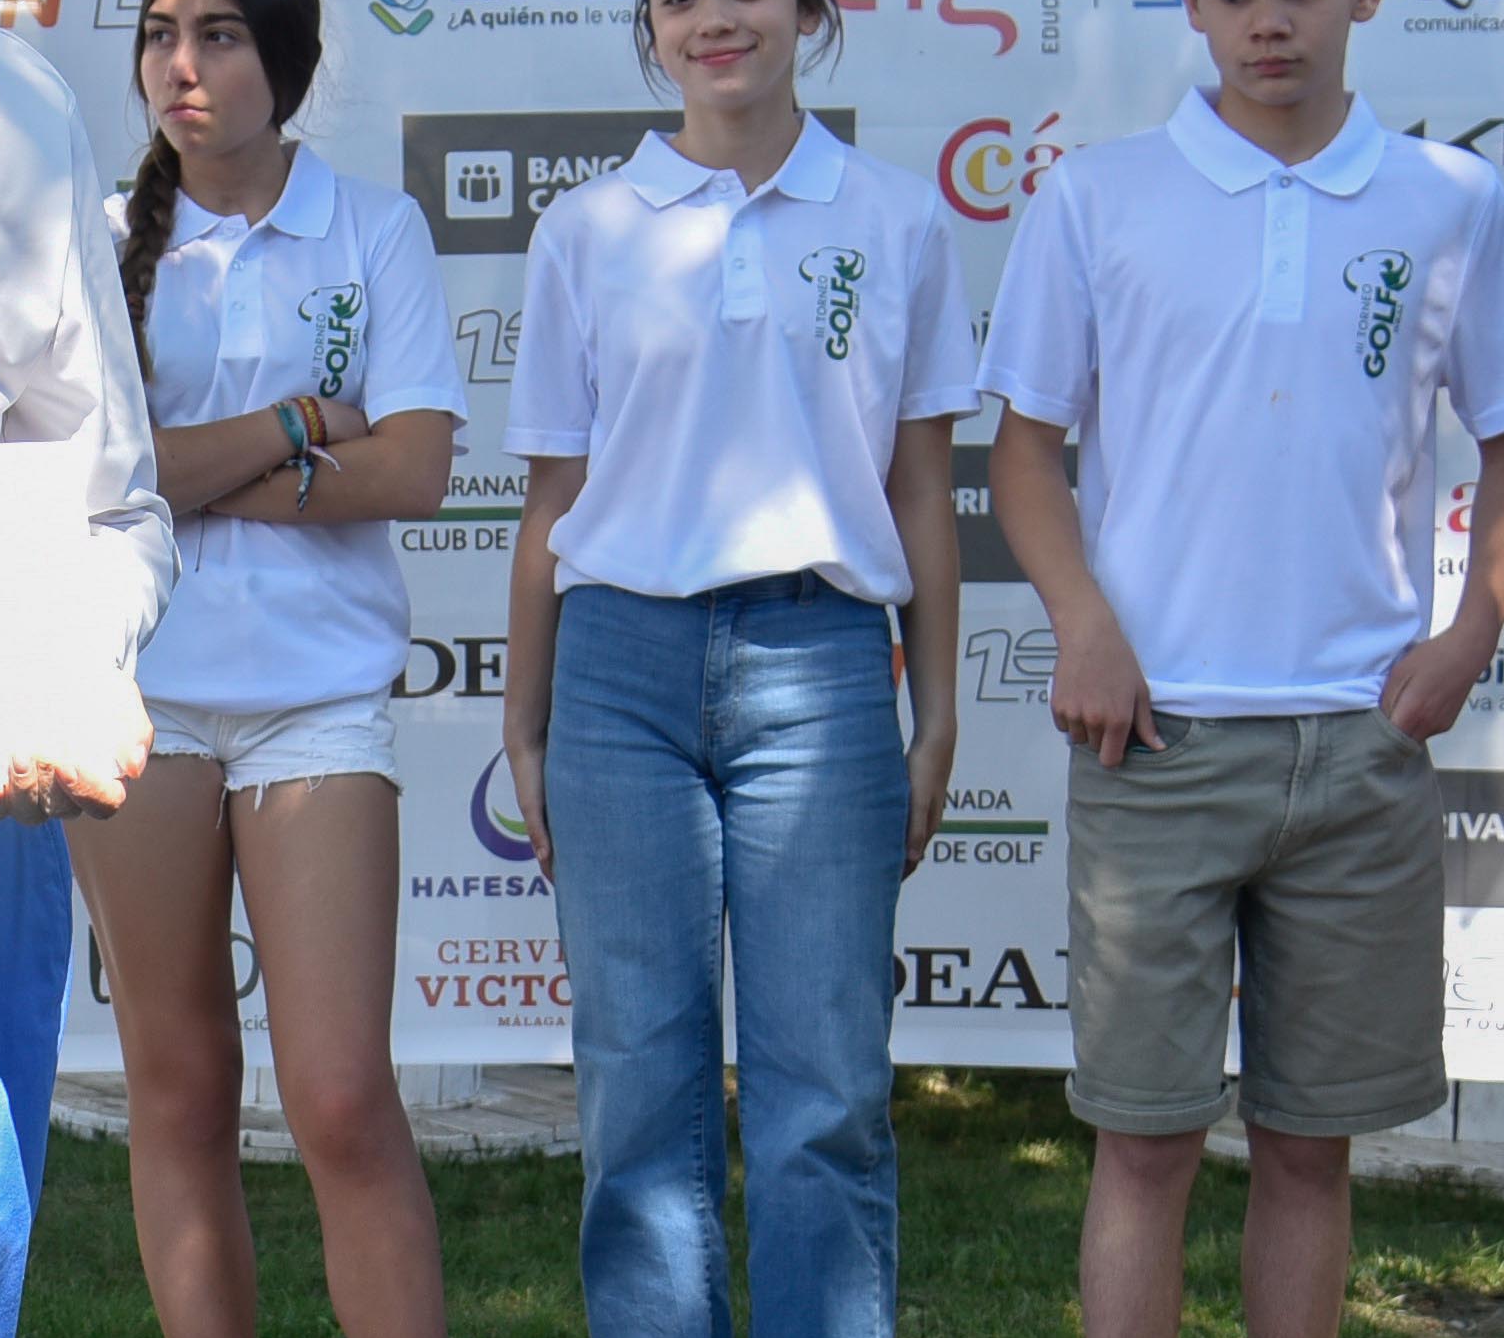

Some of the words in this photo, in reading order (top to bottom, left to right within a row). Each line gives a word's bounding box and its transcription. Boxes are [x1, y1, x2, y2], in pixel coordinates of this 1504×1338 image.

[447, 7, 483, 31] ¿A
[488, 3, 547, 30] quién
[550, 8, 579, 26] no
[583, 4, 605, 26] le
[526, 156, 624, 186] BANC
[815, 274, 828, 322] TORNEO
[1356, 283, 1373, 337] TORNEO
[825, 275, 854, 361] GOLF
[1362, 285, 1397, 379] GOLF
[313, 312, 327, 365] TORNEO
[319, 316, 352, 399] GOLF
[400, 527, 468, 552] CLUB
[473, 526, 509, 551] DE
[1468, 695, 1494, 713] va
[941, 788, 1012, 811] NADA
[933, 840, 968, 864] DE
[973, 839, 1044, 866] GOLF
[411, 875, 550, 899] HAFESA
[415, 974, 573, 1008] VICTO
